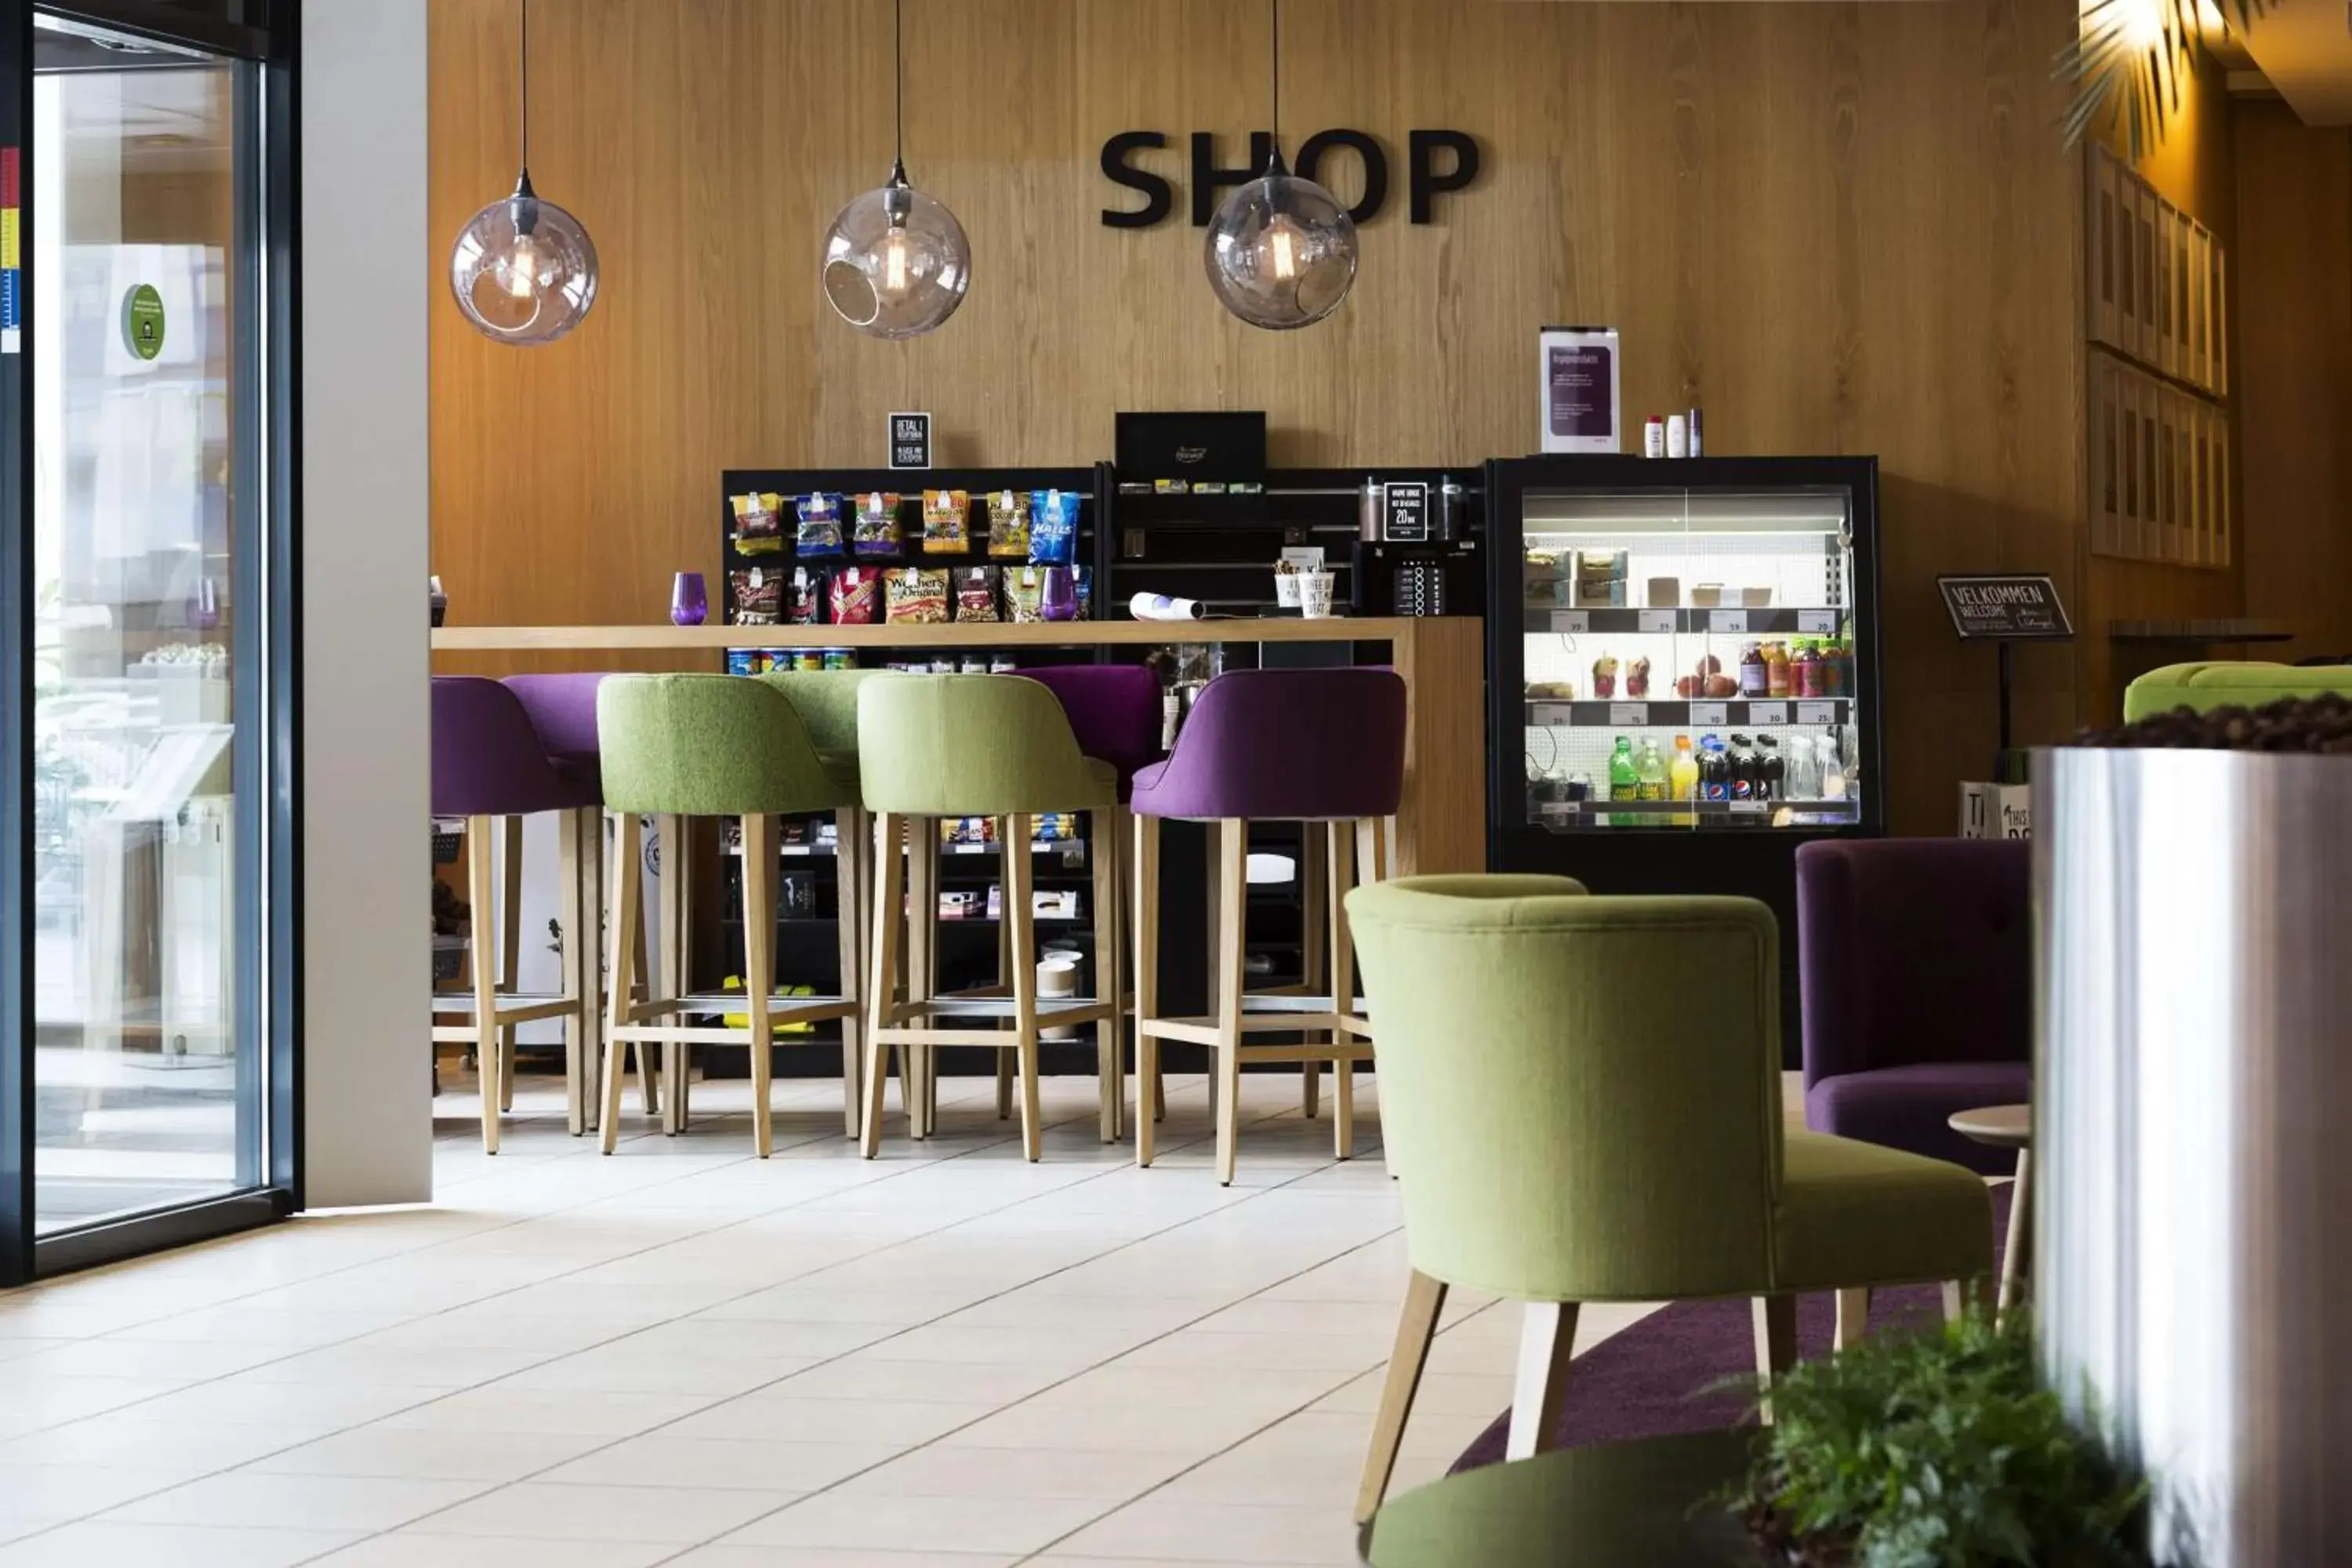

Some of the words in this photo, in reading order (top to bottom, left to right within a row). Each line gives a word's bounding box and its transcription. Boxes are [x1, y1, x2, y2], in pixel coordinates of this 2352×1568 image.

[1100, 129, 1479, 228] SHOP
[1396, 509, 1407, 524] 20
[1033, 523, 1072, 535] HALLS
[1951, 586, 2045, 604] VELKOMMEN
[1958, 605, 2008, 618] WELCOME
